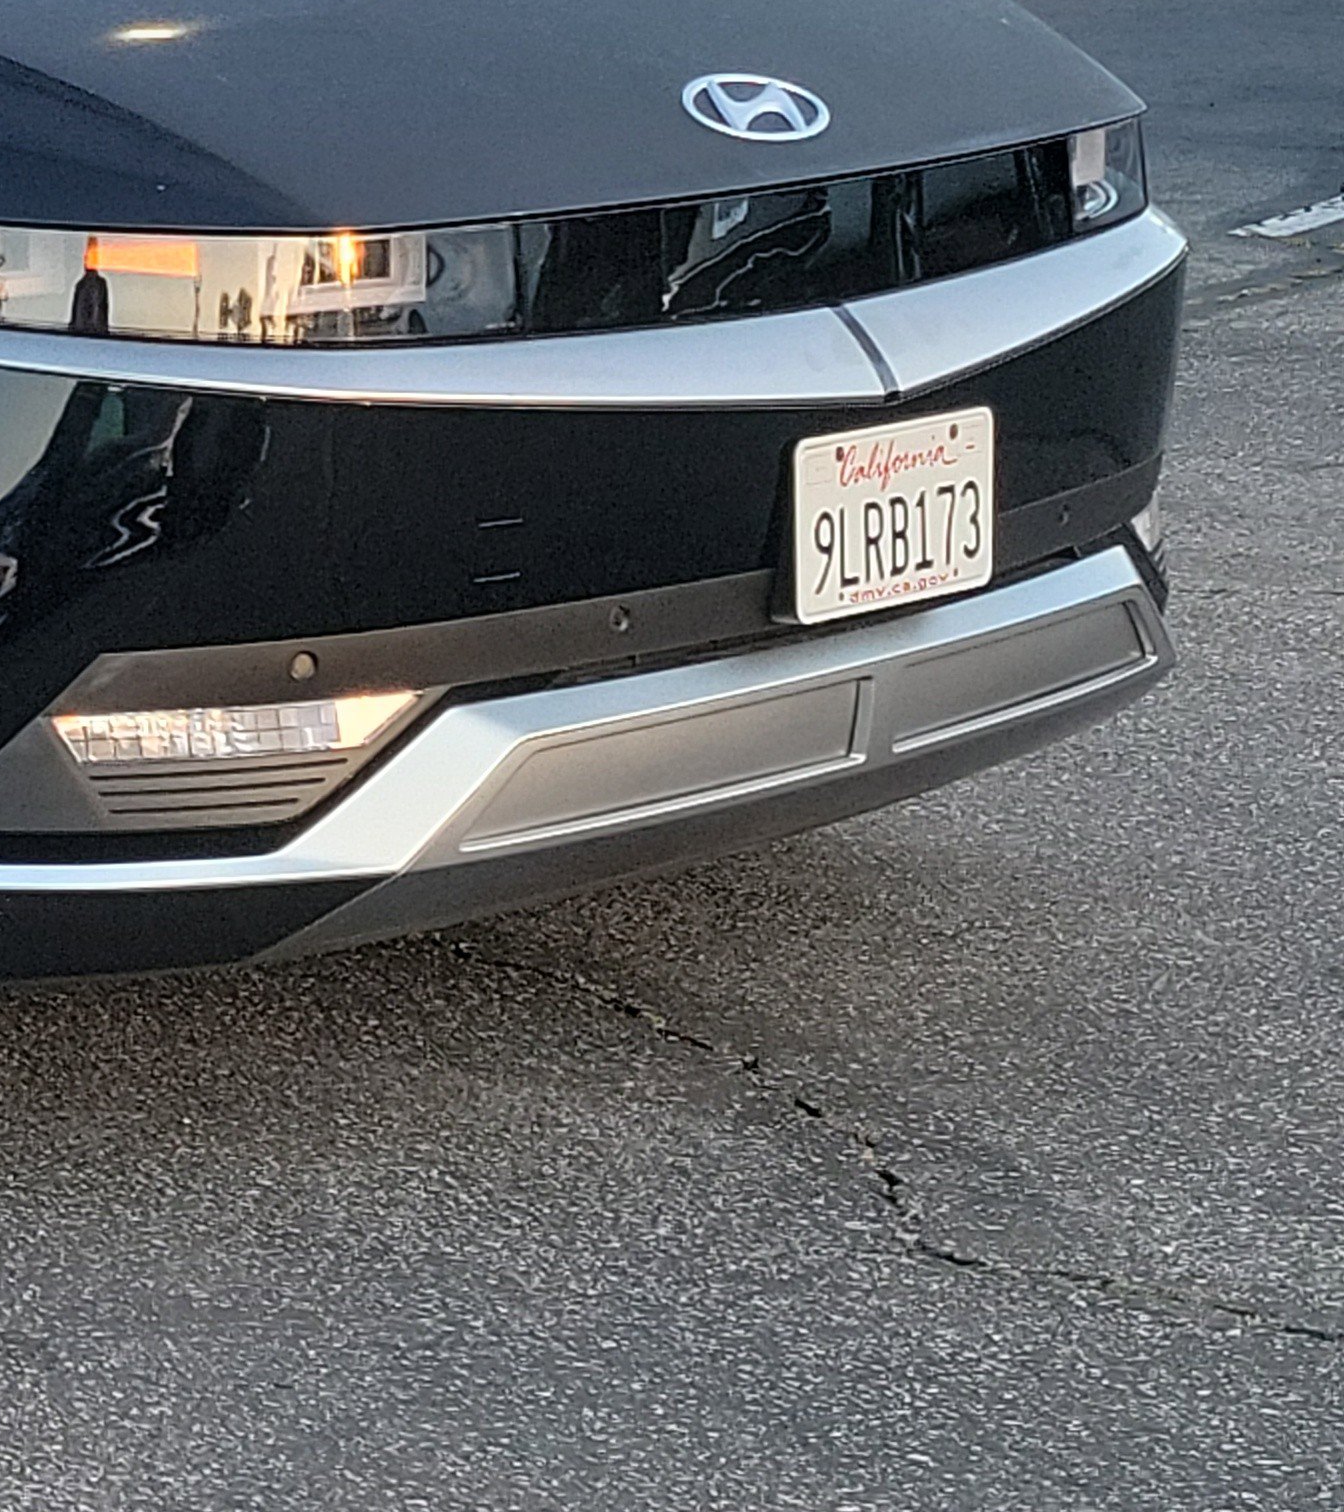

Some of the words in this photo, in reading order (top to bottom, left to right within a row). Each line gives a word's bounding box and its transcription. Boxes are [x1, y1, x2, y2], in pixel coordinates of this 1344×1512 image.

[838, 439, 958, 492] California
[814, 480, 981, 595] 9LRB173
[849, 573, 949, 603] dmv.ca.gov
